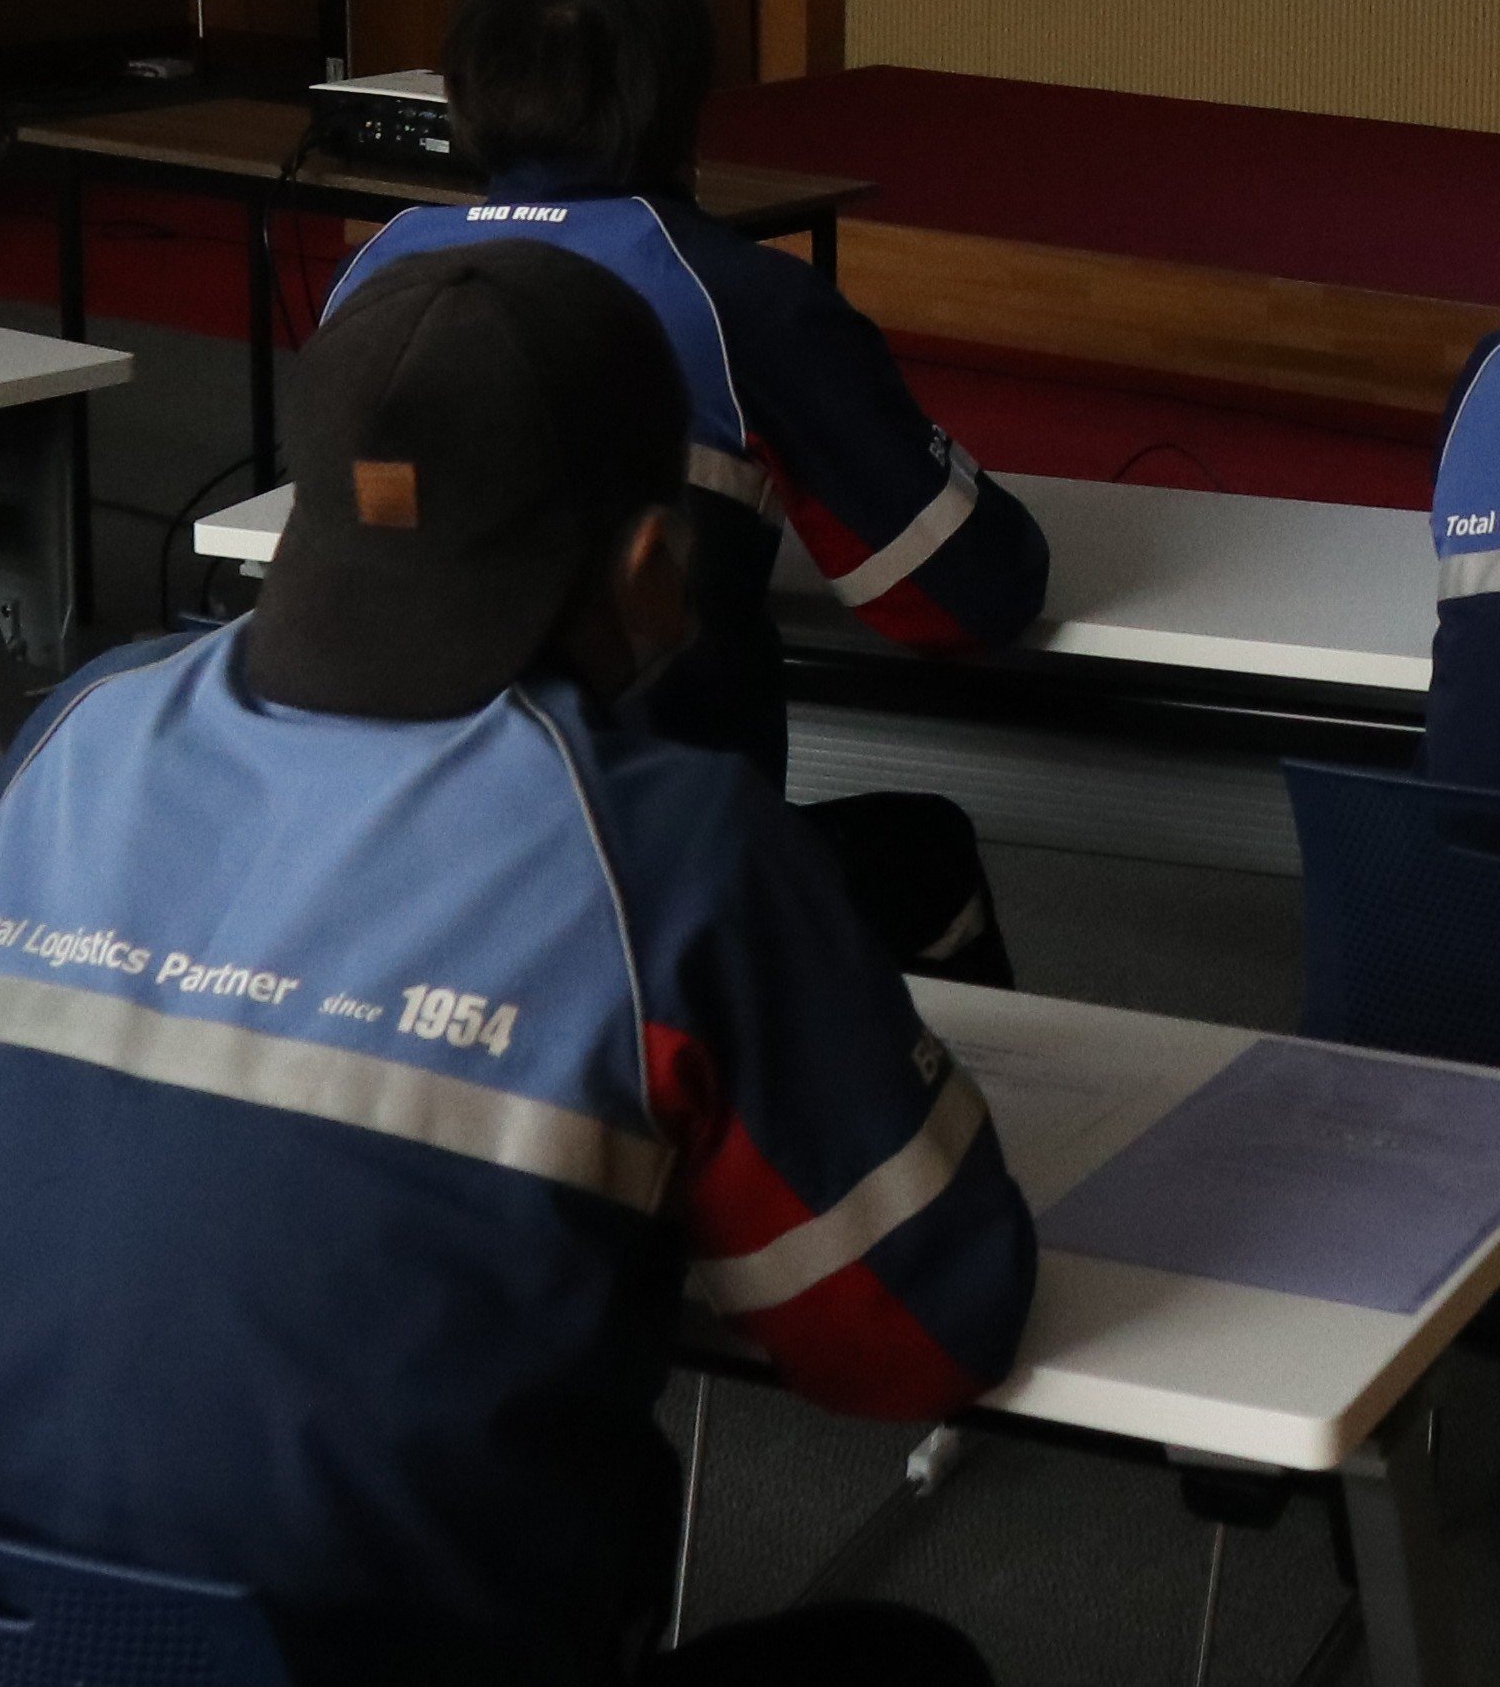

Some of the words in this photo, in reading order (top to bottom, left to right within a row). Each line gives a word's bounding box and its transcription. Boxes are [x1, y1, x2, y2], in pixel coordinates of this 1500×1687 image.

[466, 205, 511, 221] SHO
[511, 206, 568, 223] RIKU
[1445, 512, 1495, 537] Total
[22, 923, 152, 976] Logistics
[154, 950, 300, 1005] Partner
[317, 990, 386, 1024] since
[396, 982, 520, 1059] 1954
